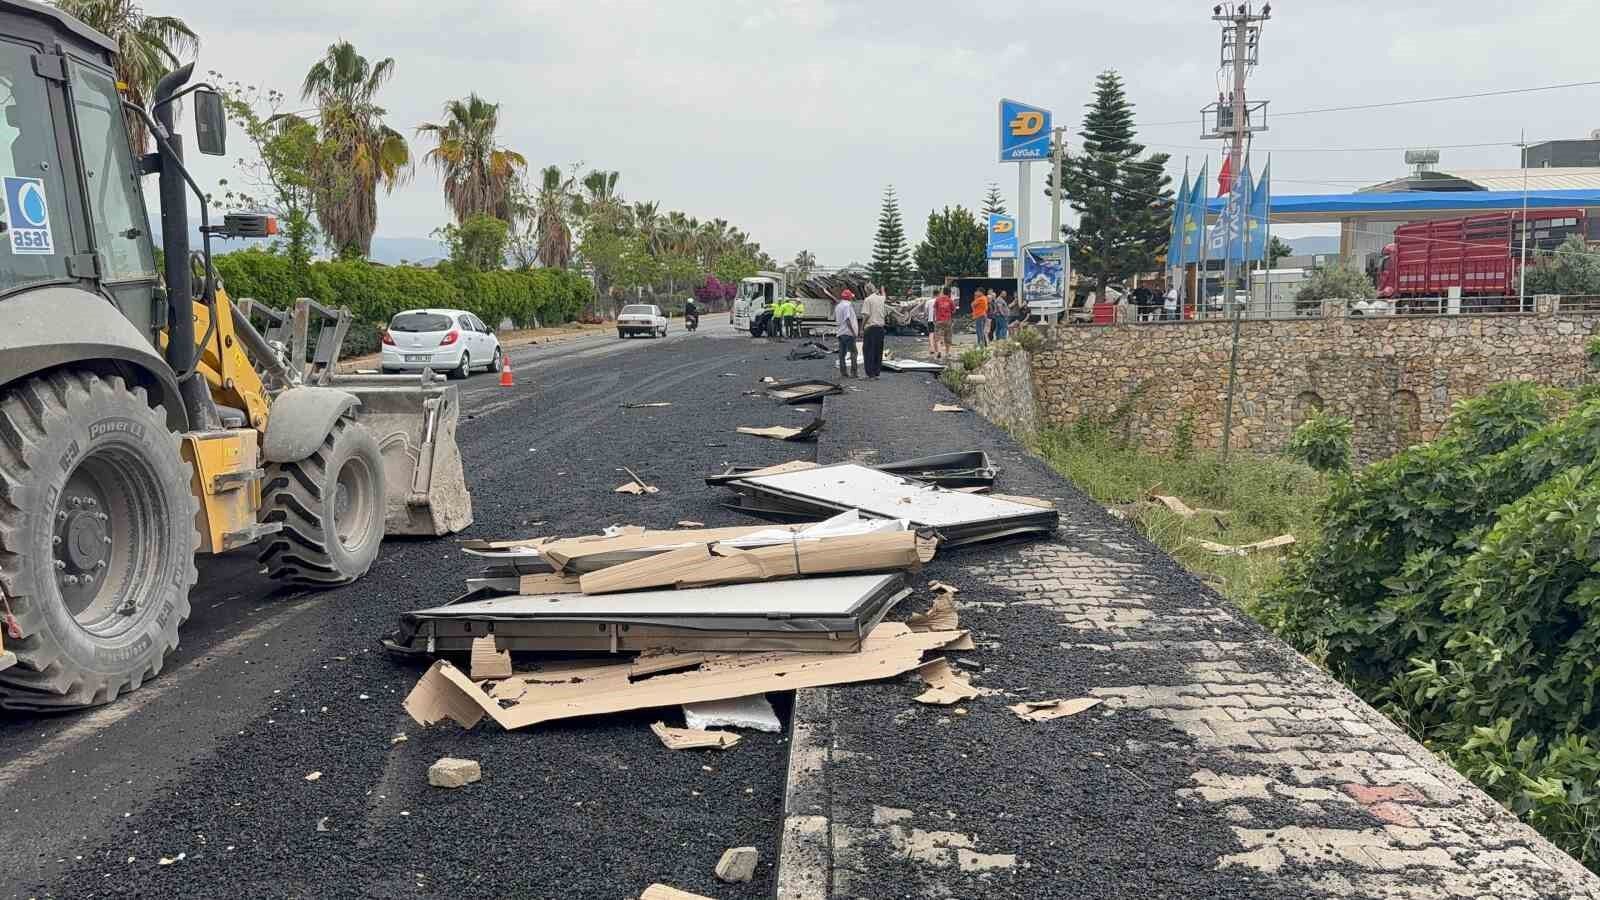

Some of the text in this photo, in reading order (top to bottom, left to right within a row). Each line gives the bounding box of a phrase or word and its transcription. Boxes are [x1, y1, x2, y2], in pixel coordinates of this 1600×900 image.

[1012, 148, 1041, 158] AYGAZ
[14, 230, 50, 247] asat
[90, 421, 128, 439] Power
